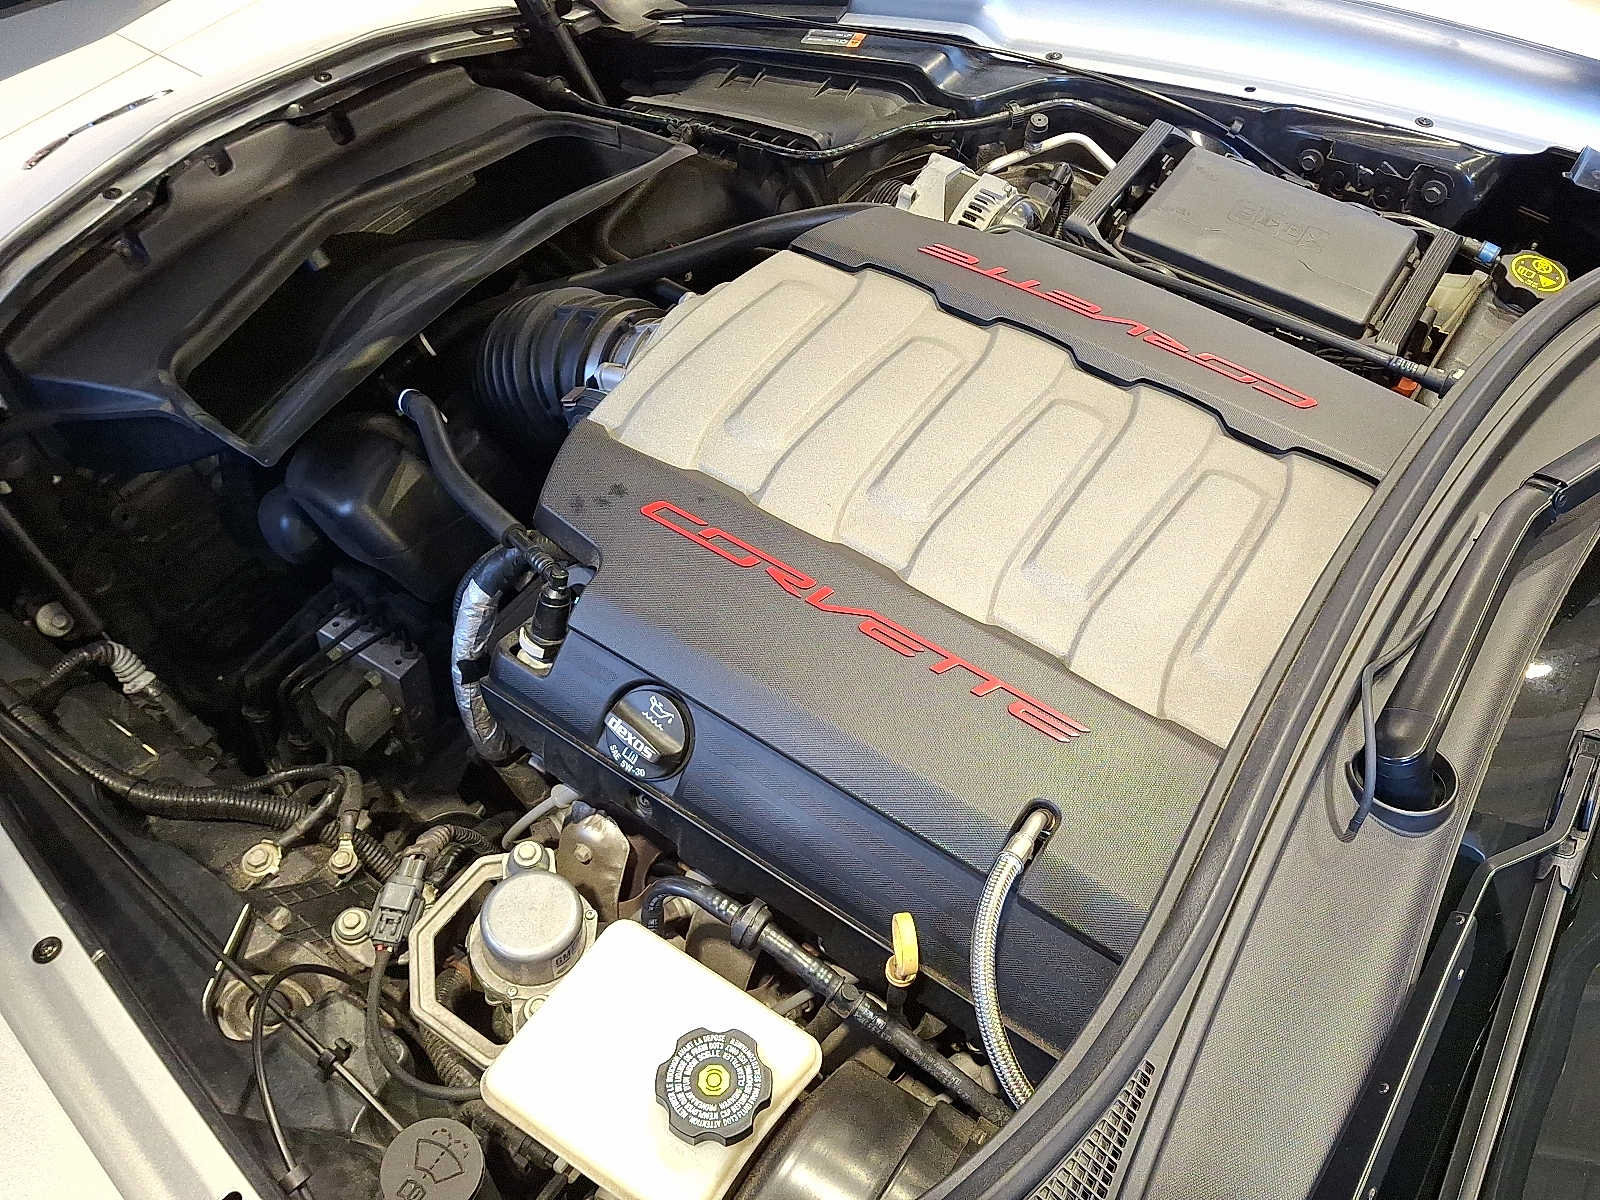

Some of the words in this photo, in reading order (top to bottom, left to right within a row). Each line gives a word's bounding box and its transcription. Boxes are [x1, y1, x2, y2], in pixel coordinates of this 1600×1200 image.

[916, 242, 1319, 410] CORVETTE
[639, 500, 1091, 743] CORVETTE
[607, 715, 657, 760] dexos
[609, 744, 622, 761] SAE
[620, 759, 646, 777] 5W-30
